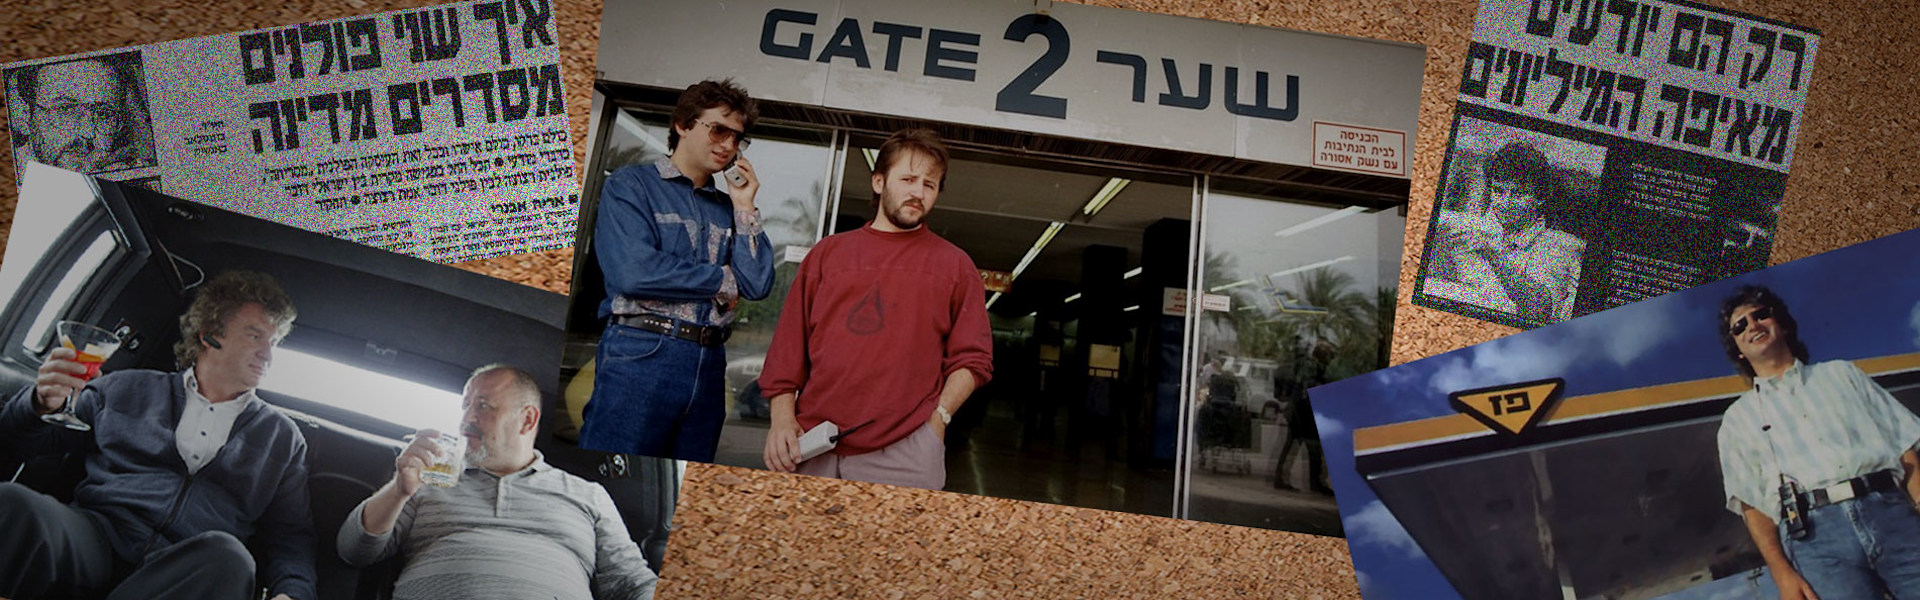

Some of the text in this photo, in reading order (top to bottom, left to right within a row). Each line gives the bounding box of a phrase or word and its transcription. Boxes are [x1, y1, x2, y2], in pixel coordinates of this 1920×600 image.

[239, 0, 554, 85] איך שני פולנים
[759, 8, 1071, 120] GATE 2
[1667, 11, 1734, 75] הם
[1739, 27, 1805, 90] רק
[249, 64, 565, 154] מסדרים מדינה
[1096, 50, 1300, 122] שער
[1459, 41, 1794, 164] מאיפה המיליונים
[1321, 152, 1398, 169] עם נשק אסורה
[1324, 141, 1394, 157] לבית הנתיבות
[1340, 131, 1379, 143] הכניסה
[1488, 391, 1530, 415] פז
